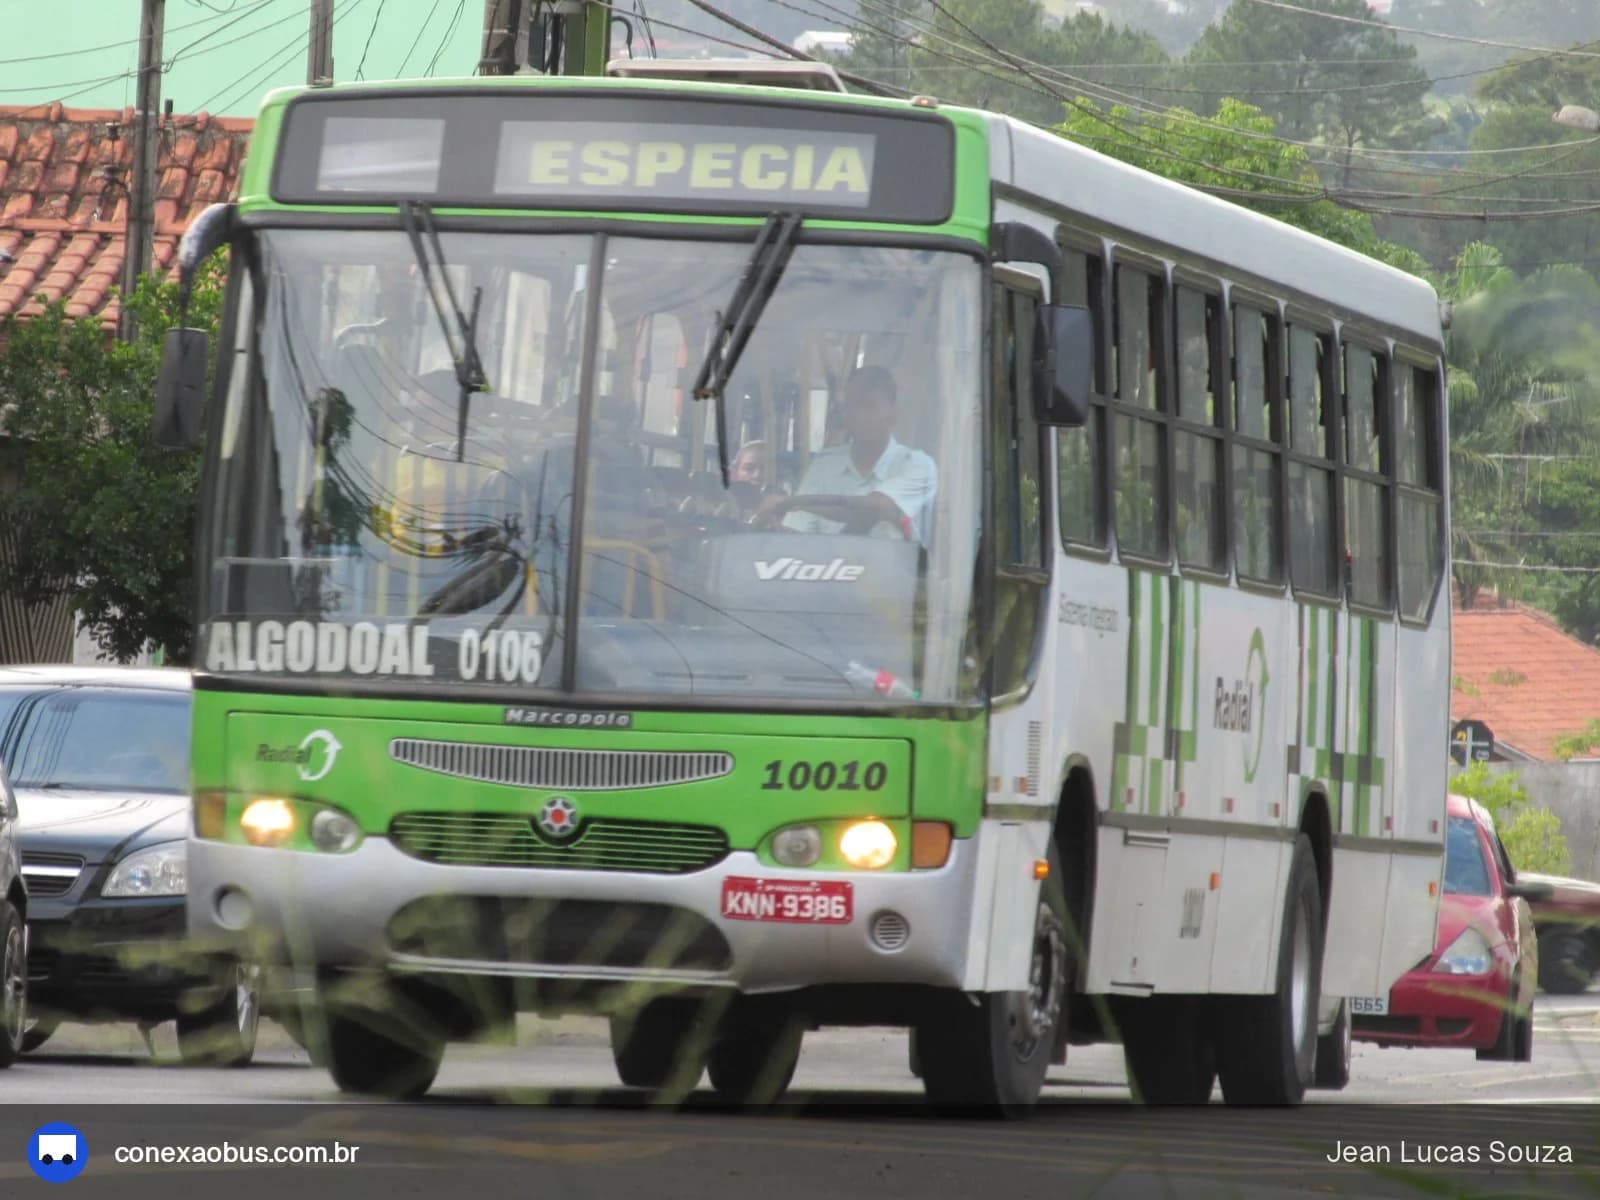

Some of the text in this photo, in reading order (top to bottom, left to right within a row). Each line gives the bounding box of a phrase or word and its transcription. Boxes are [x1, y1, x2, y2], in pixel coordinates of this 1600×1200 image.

[528, 139, 869, 193] ESPECIA
[753, 557, 865, 581] Viale
[206, 620, 543, 683] ALGODOAL 0106
[505, 708, 630, 726] Marcopolo
[256, 743, 312, 764] Radial
[761, 760, 888, 791] 10010
[726, 890, 847, 919] KNN-9386
[1349, 997, 1384, 1012] 665
